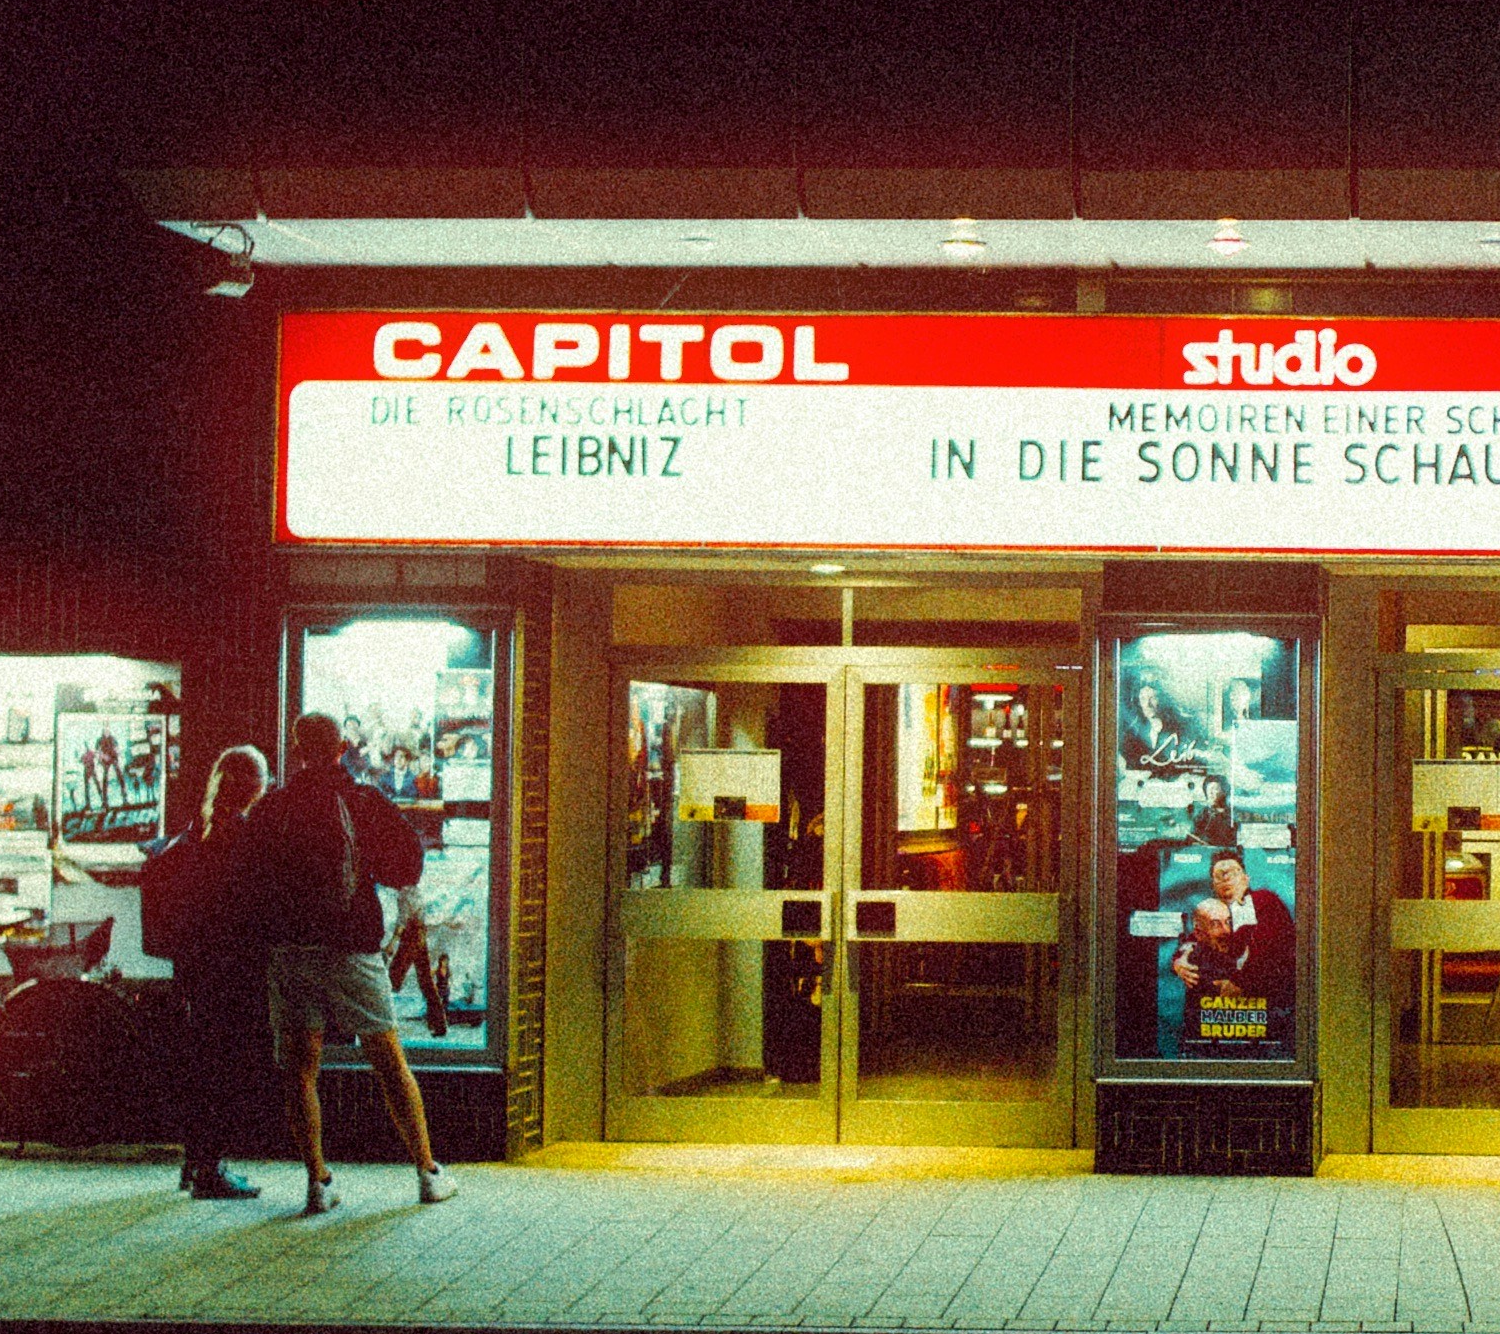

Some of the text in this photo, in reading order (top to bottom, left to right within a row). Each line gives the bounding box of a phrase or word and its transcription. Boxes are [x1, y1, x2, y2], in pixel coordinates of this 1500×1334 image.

[372, 321, 850, 381] CAPITOL
[1182, 327, 1378, 387] studio
[370, 396, 750, 427] DIE ROSENSCHLACHT
[1107, 402, 1307, 434] MEMOIREN
[1323, 405, 1426, 435] EINER
[505, 434, 684, 478] LEIBNIZ
[930, 438, 977, 480] IN
[1018, 438, 1103, 483] DIE
[1137, 439, 1313, 485] SONNE
[1200, 996, 1268, 1010] GANZER
[1200, 1009, 1268, 1024] HALBER
[1200, 1023, 1268, 1038] BRUDER
